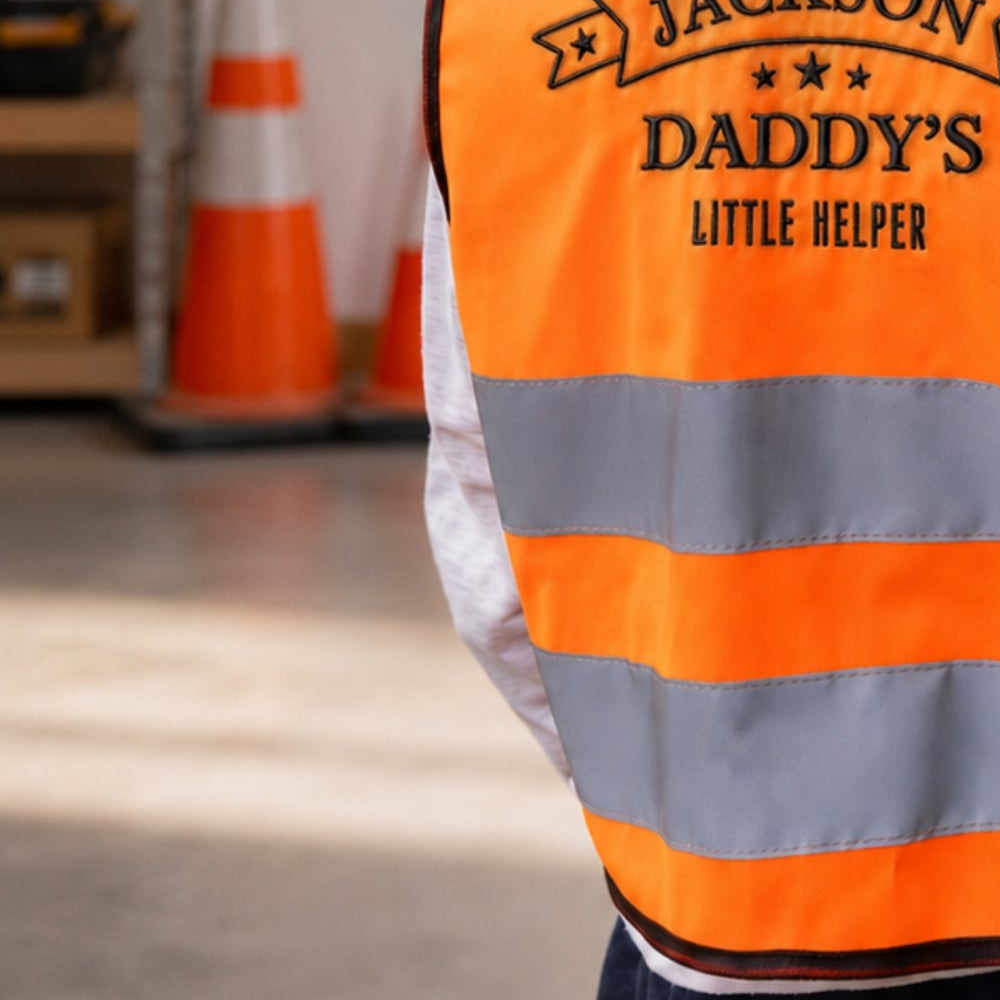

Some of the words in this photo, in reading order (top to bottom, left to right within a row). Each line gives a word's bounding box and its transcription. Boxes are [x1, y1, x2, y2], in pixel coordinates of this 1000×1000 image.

[640, 113, 985, 174] DADDY’S
[692, 199, 795, 246] LITTLE
[813, 200, 927, 250] HELPER
